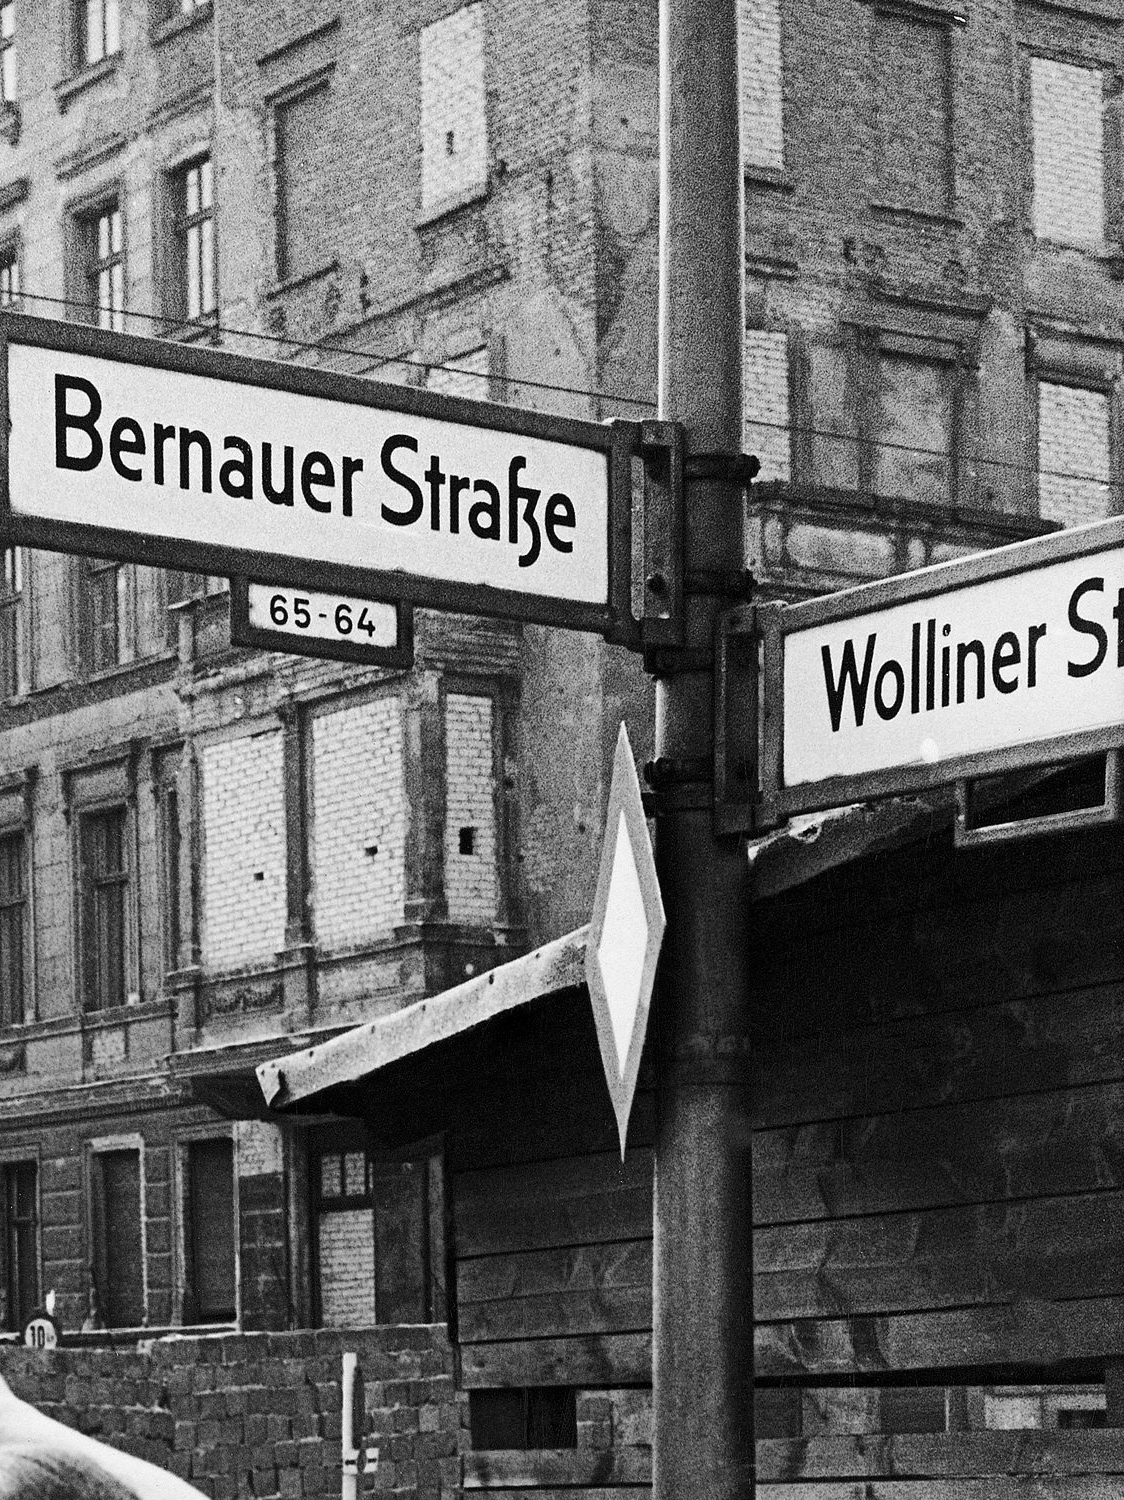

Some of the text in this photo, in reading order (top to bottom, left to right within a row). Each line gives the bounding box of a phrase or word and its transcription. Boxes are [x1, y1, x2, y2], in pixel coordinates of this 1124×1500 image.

[55, 374, 577, 568] Bernauer Straße
[821, 618, 1047, 733] Wolliner
[30, 1325, 45, 1349] 10
